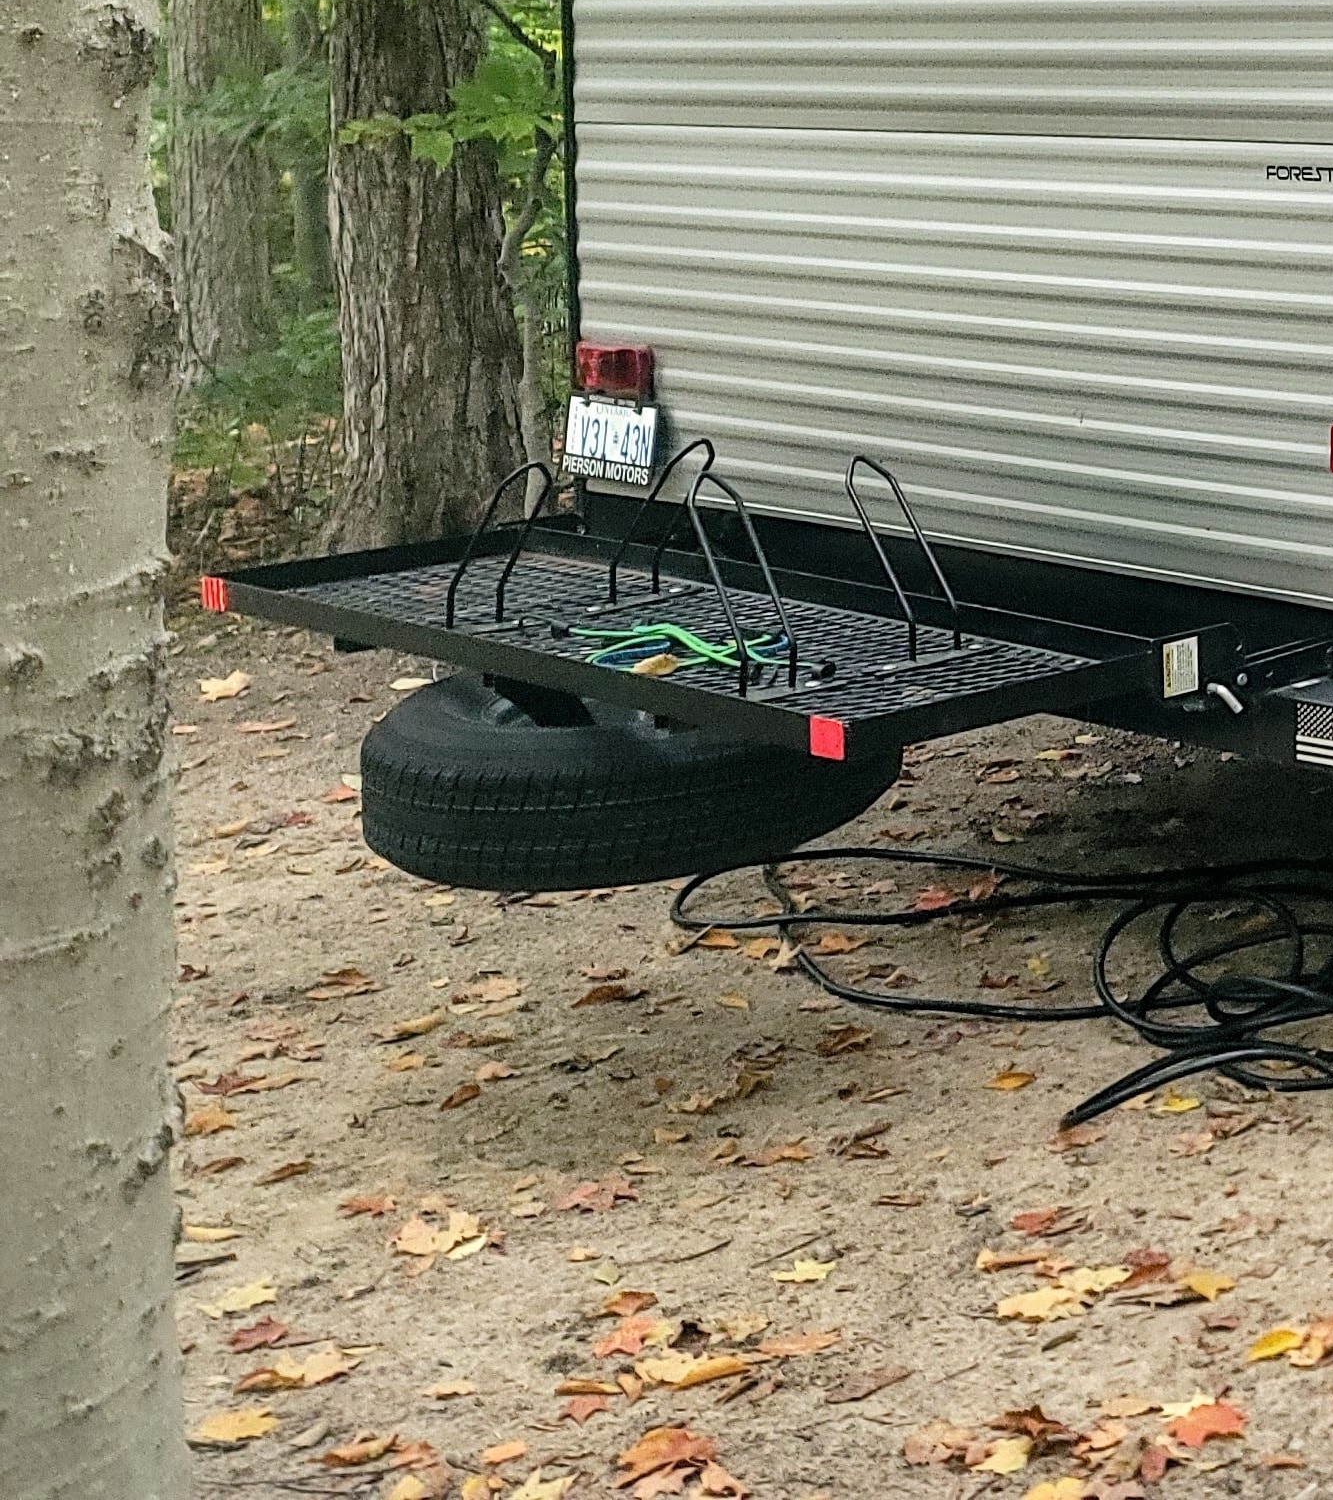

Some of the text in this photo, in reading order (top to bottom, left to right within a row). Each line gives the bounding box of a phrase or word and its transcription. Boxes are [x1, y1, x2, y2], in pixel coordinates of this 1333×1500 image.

[620, 421, 651, 468] 43N
[562, 454, 649, 486] PIERSON MOTORS
